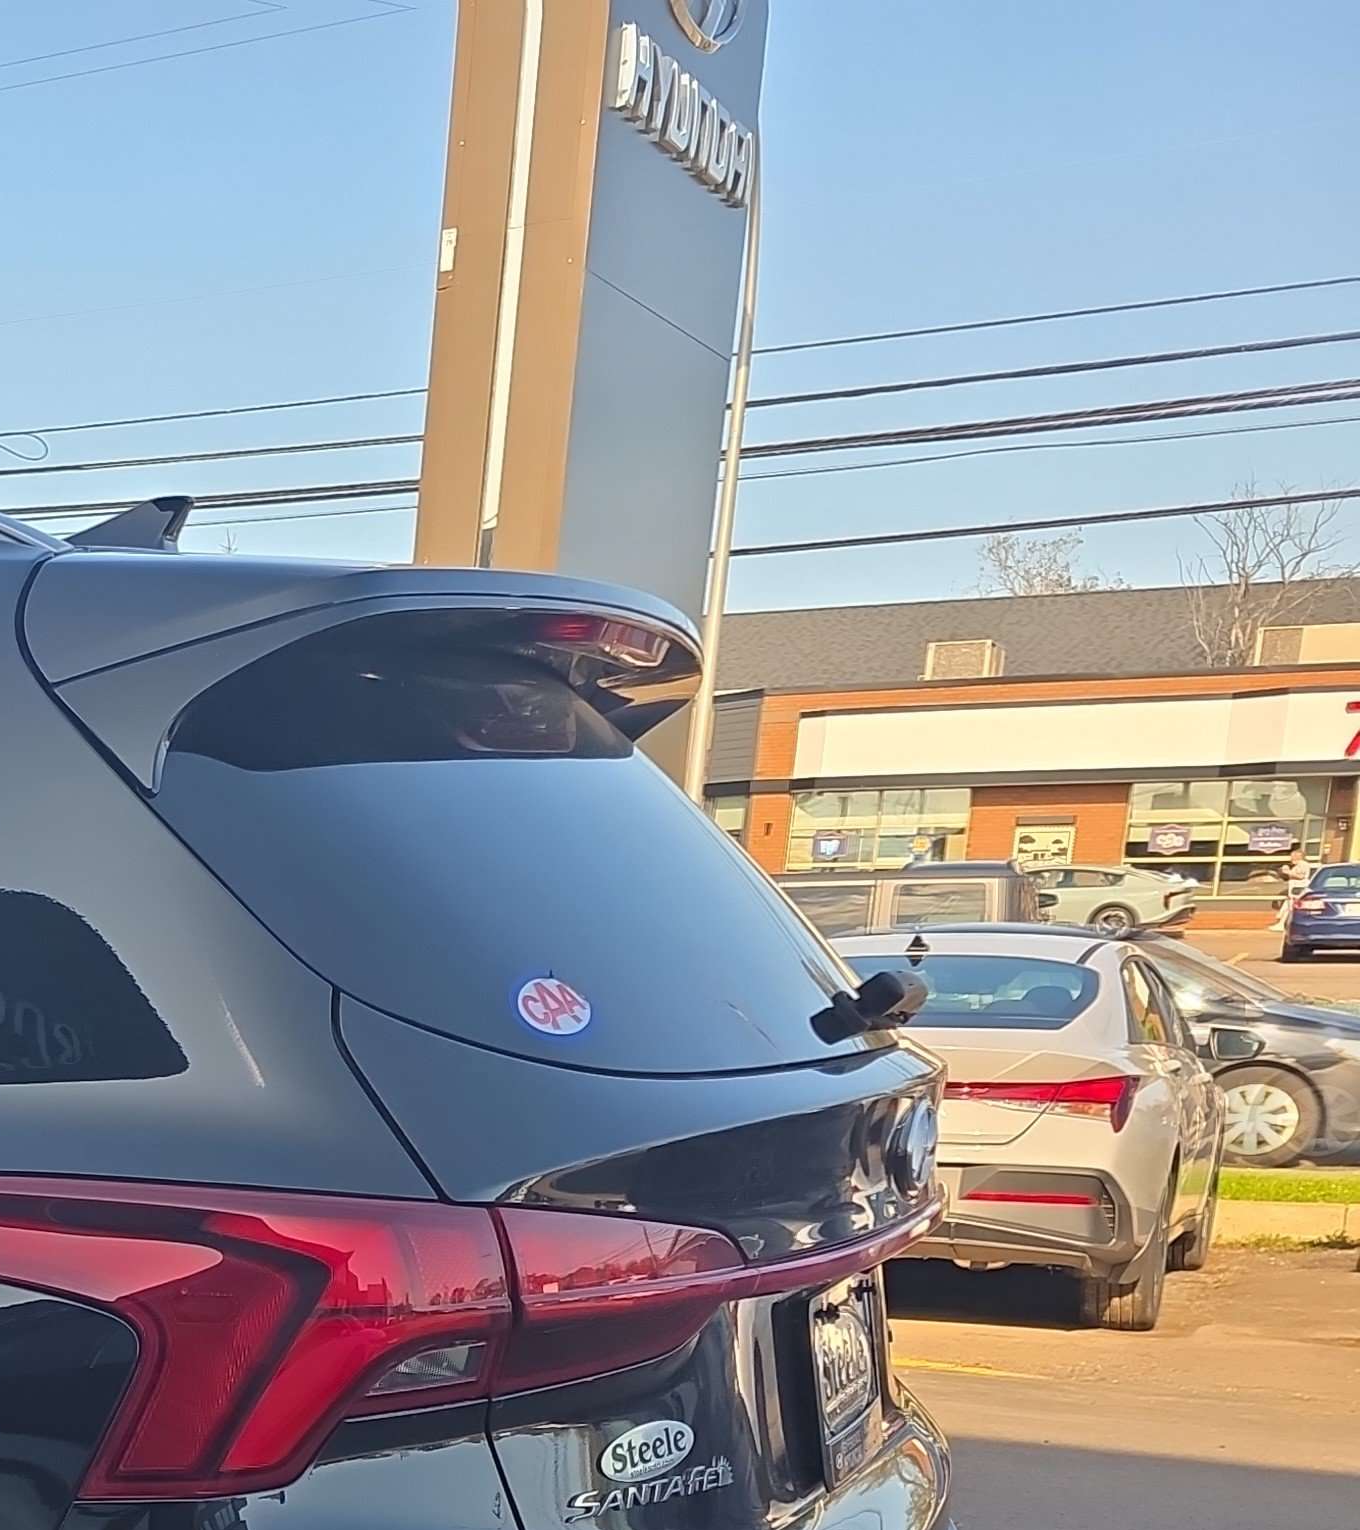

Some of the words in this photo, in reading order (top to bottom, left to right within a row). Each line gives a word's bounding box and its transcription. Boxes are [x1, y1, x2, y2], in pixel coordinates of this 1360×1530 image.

[522, 982, 587, 1030] CAA
[611, 1427, 687, 1474] Steele
[565, 1475, 685, 1524] SANTA
